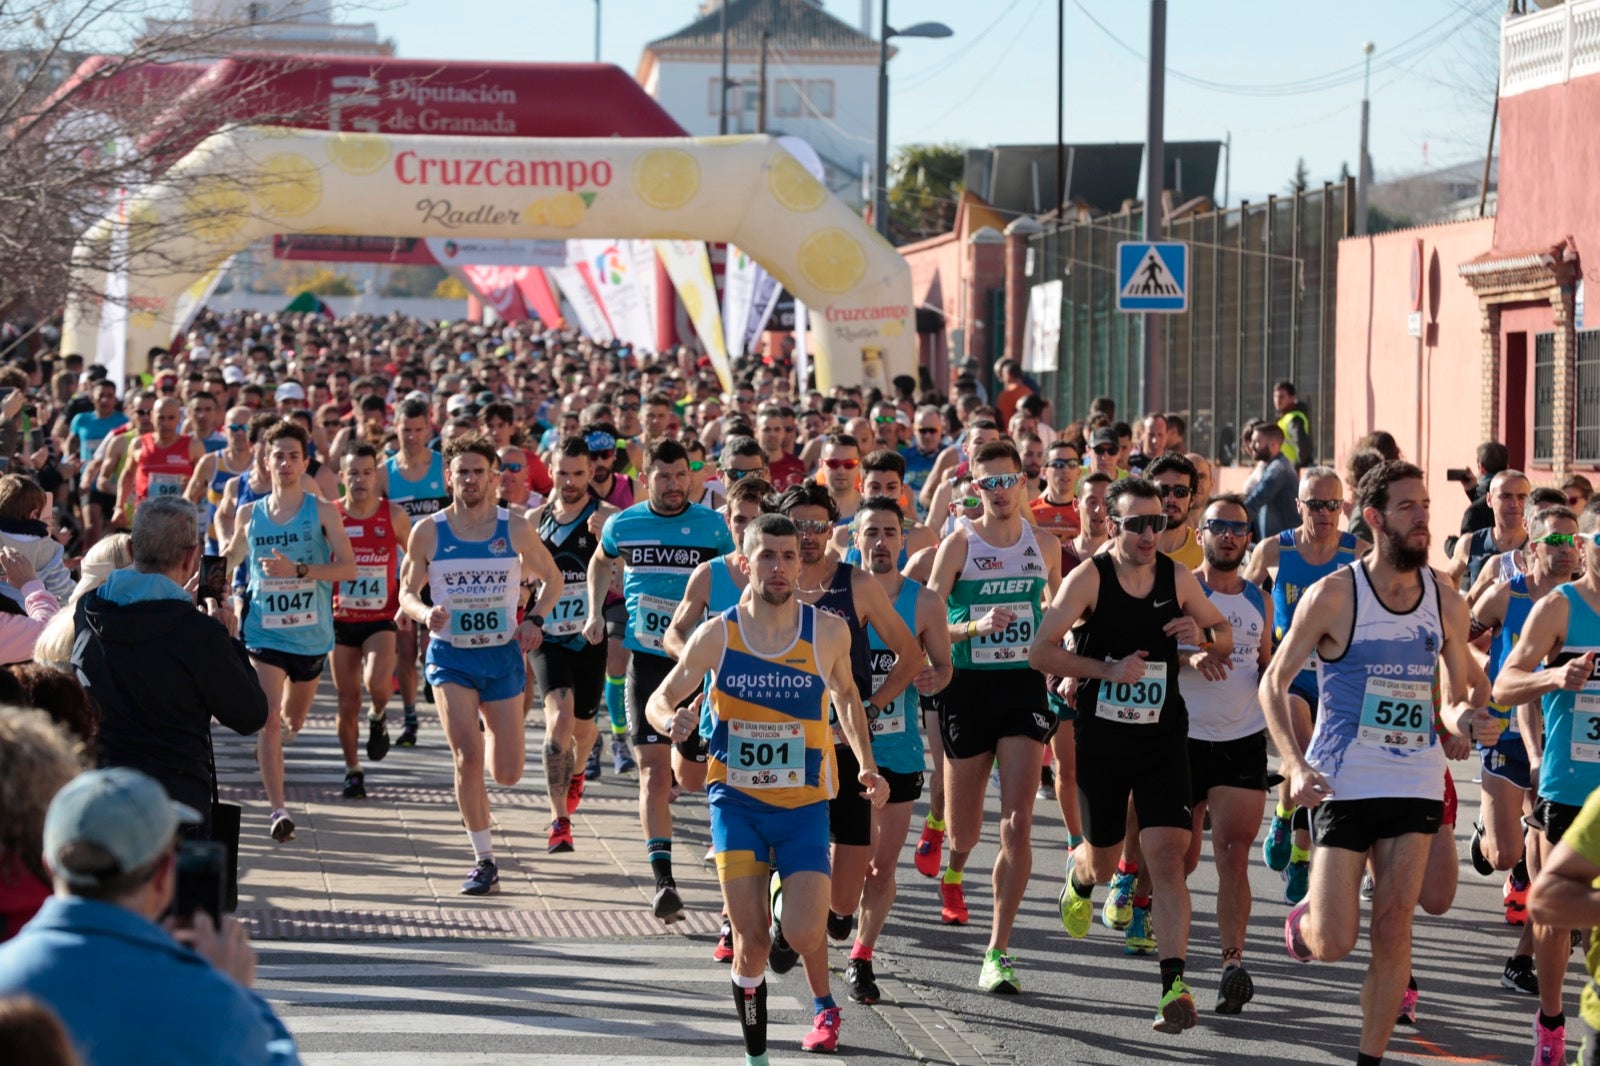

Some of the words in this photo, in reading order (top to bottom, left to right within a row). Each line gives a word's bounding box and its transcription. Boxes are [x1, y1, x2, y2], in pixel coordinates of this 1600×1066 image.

[389, 80, 517, 105] Diputación
[388, 112, 415, 131] de
[417, 110, 517, 133] Granada
[394, 149, 612, 192] Cruzcampo
[416, 198, 520, 228] Radler
[255, 531, 299, 547] nerja
[631, 547, 700, 566] BEWOR
[445, 575, 507, 585] CAXAR
[562, 570, 586, 580] hine
[348, 580, 379, 595] 714
[979, 580, 1034, 595] ATLEET
[265, 592, 314, 613] 1047
[461, 611, 498, 631] 686
[1365, 664, 1403, 675] TODO
[1407, 664, 1435, 676] SUMA
[726, 671, 812, 693] agustinos
[739, 691, 800, 699] GRANADA
[1104, 680, 1162, 705] 1030
[1374, 700, 1423, 729] 526
[739, 742, 789, 767] 501
